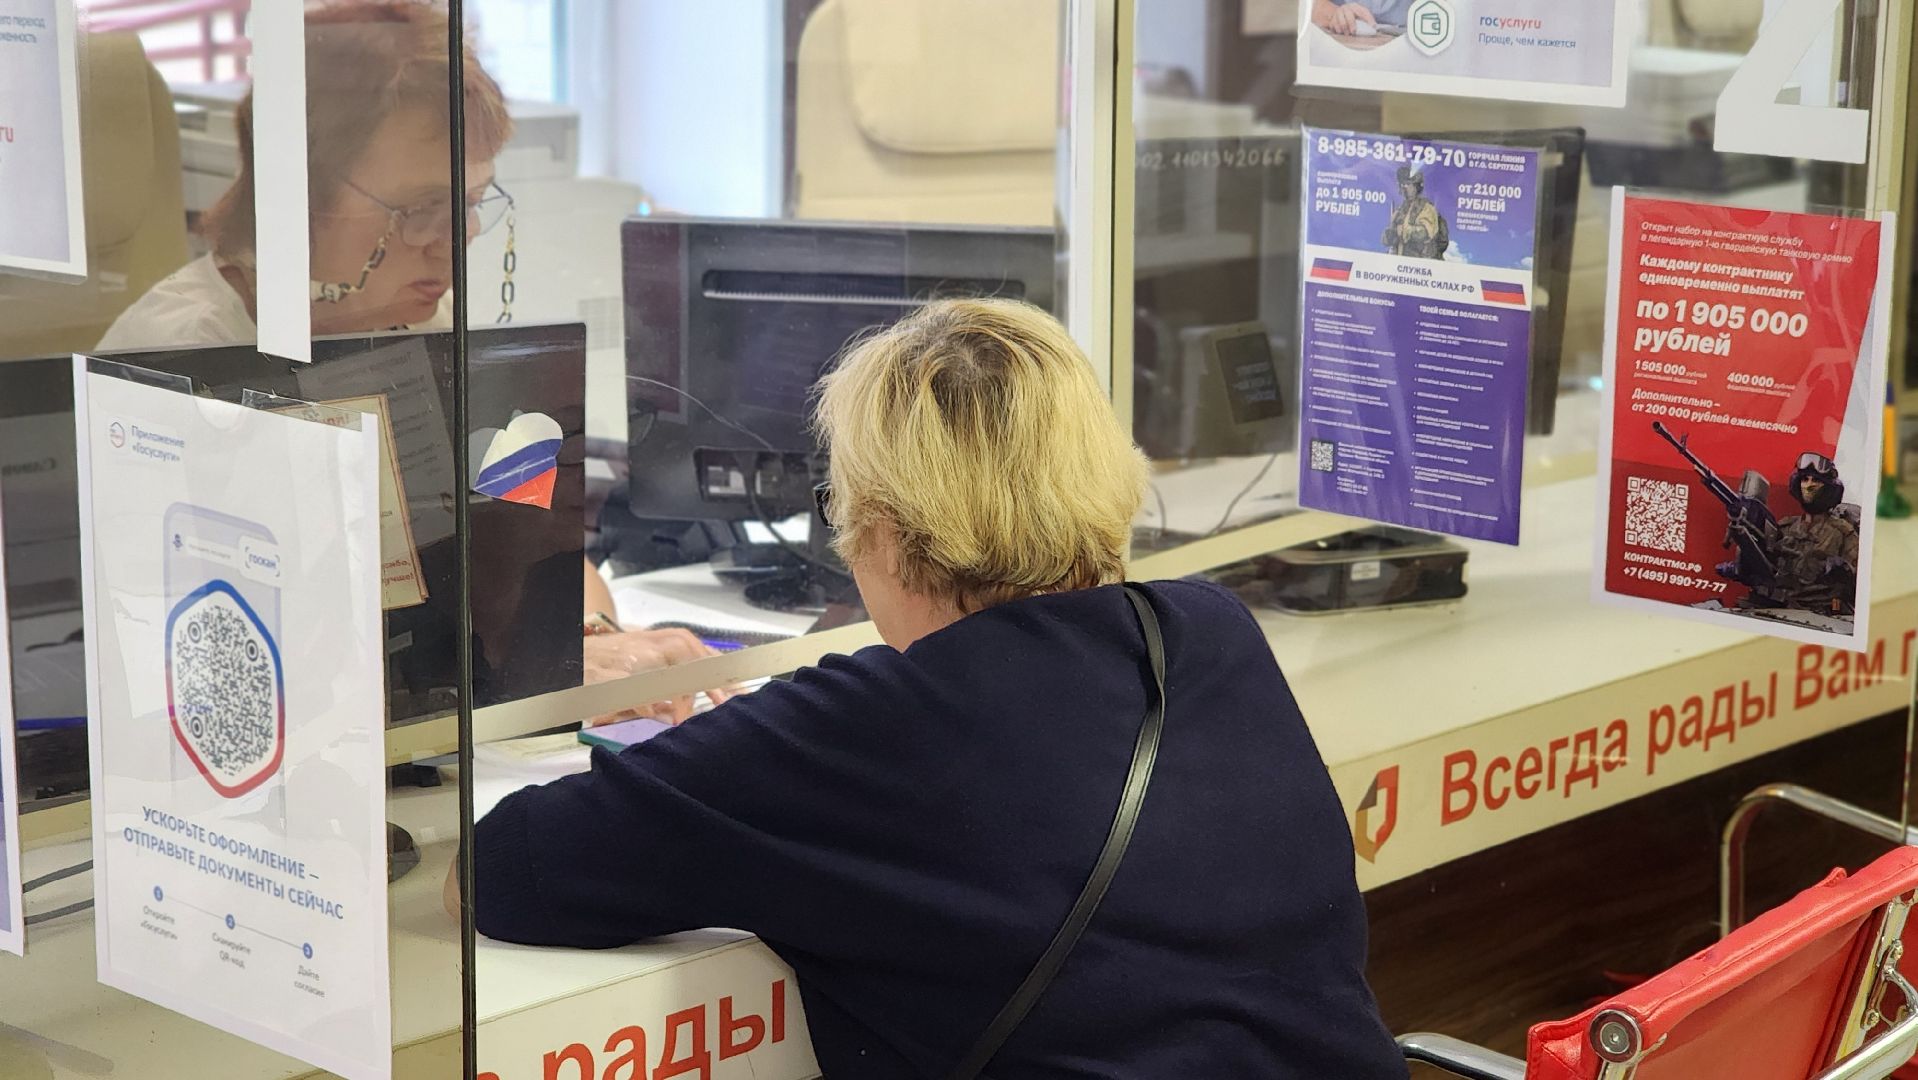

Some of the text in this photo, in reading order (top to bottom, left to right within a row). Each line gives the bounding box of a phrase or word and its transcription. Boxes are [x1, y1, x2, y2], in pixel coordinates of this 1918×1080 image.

[13, 17, 46, 29] переход
[1478, 33, 1576, 48] Проще, чем кажется
[1318, 136, 1466, 168] 8-985-361-79-70
[1468, 152, 1500, 162] ГОРЯЧАЯ
[1488, 162, 1525, 172] СЕРПУХОВ
[1316, 187, 1386, 203] до 1 905 000
[1458, 183, 1521, 199] от 210 000
[1315, 200, 1360, 216] РУБЛЕЙ
[1458, 197, 1506, 212] РУБЛЕЙ
[1641, 221, 1674, 233] Открыт
[1675, 225, 1700, 236] набор
[1714, 230, 1769, 244] контрактную
[1770, 234, 1803, 247] службу
[1648, 234, 1703, 248] легендарную
[1720, 242, 1777, 257] гвардейскую
[1779, 249, 1821, 261] танковую
[1822, 253, 1853, 264] армию
[1397, 264, 1432, 277] СЛУЖБА
[1640, 254, 1793, 284] Каждому контрактнику
[1356, 270, 1475, 293] В ВООРУЖЕННЫХ СИЛАХ РФ
[1639, 272, 1805, 300] единовременно выплатят
[1636, 300, 1669, 320] по
[1691, 302, 1746, 329] 905
[1750, 308, 1809, 338] 000
[1634, 327, 1731, 357] рублей
[1663, 363, 1686, 376] 000
[1727, 372, 1750, 385] 400
[1751, 374, 1774, 388] 000
[1632, 387, 1713, 408] Дополнительно
[1632, 402, 1798, 435] от 200 000 рублей ежемесячно
[131, 425, 184, 449] Приложение
[1623, 551, 1702, 573] КОНТРАКТМО.РФ
[1623, 567, 1728, 593] +7 (495) 990-77-77
[1440, 718, 1628, 827] Всегда
[1647, 672, 1778, 775] рады
[1793, 638, 1885, 710] Вам
[142, 806, 206, 844] УСКОРЬТЕ
[207, 831, 306, 880] ОФОРМЛЕНИЕ
[123, 827, 344, 920] ОТПРАВЬТЕ ДОКУМЕНТЫ СЕЙЧАС
[143, 905, 175, 925] Откройте
[211, 931, 251, 955] Сканируйте
[297, 964, 320, 981] Дайте
[294, 980, 326, 998] согласие
